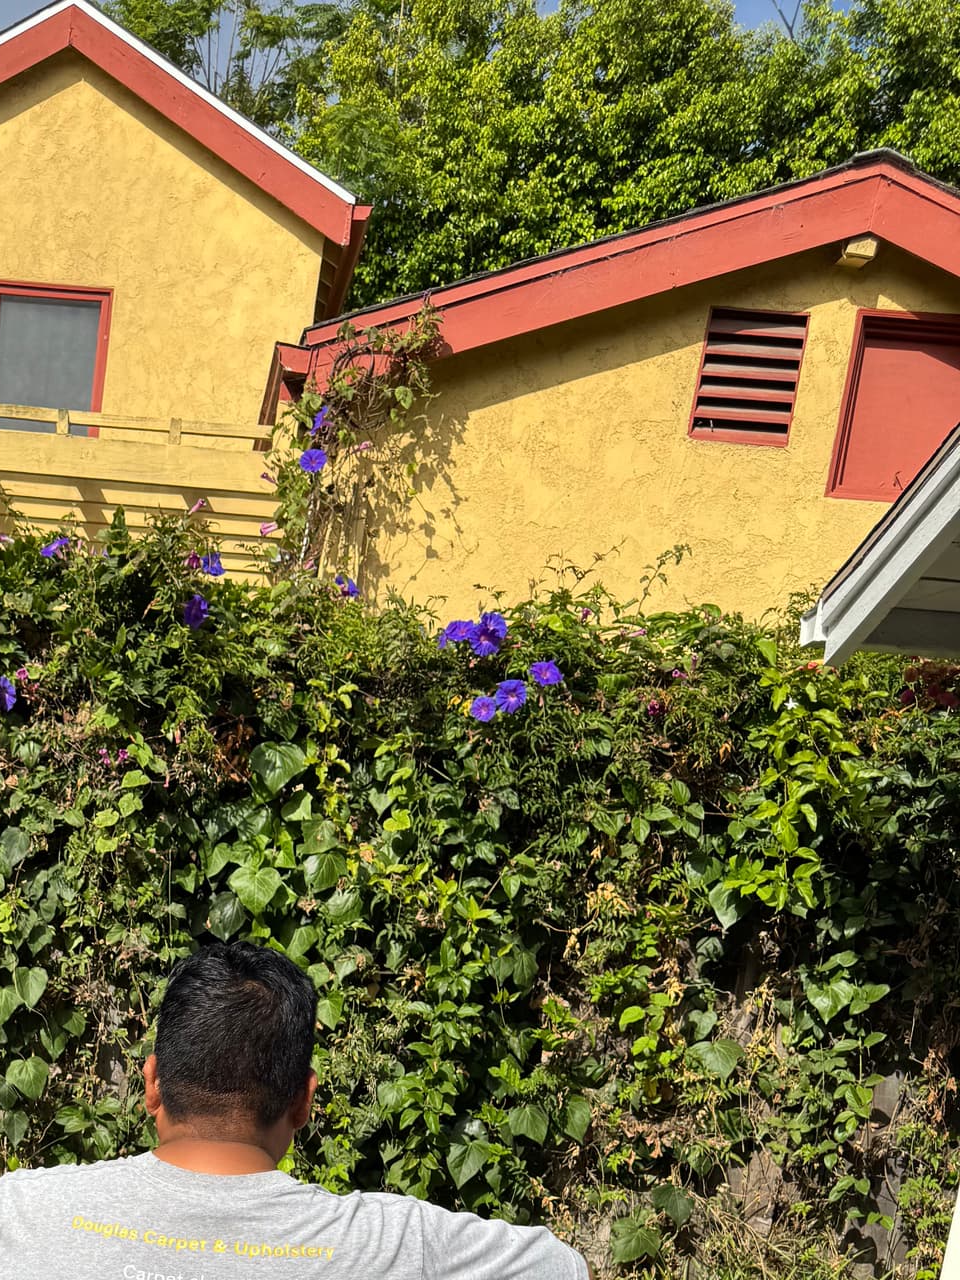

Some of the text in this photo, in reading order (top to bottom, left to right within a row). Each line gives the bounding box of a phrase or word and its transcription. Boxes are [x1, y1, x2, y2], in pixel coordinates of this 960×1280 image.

[71, 1216, 335, 1261] Douglas Carpet & Upholstery
